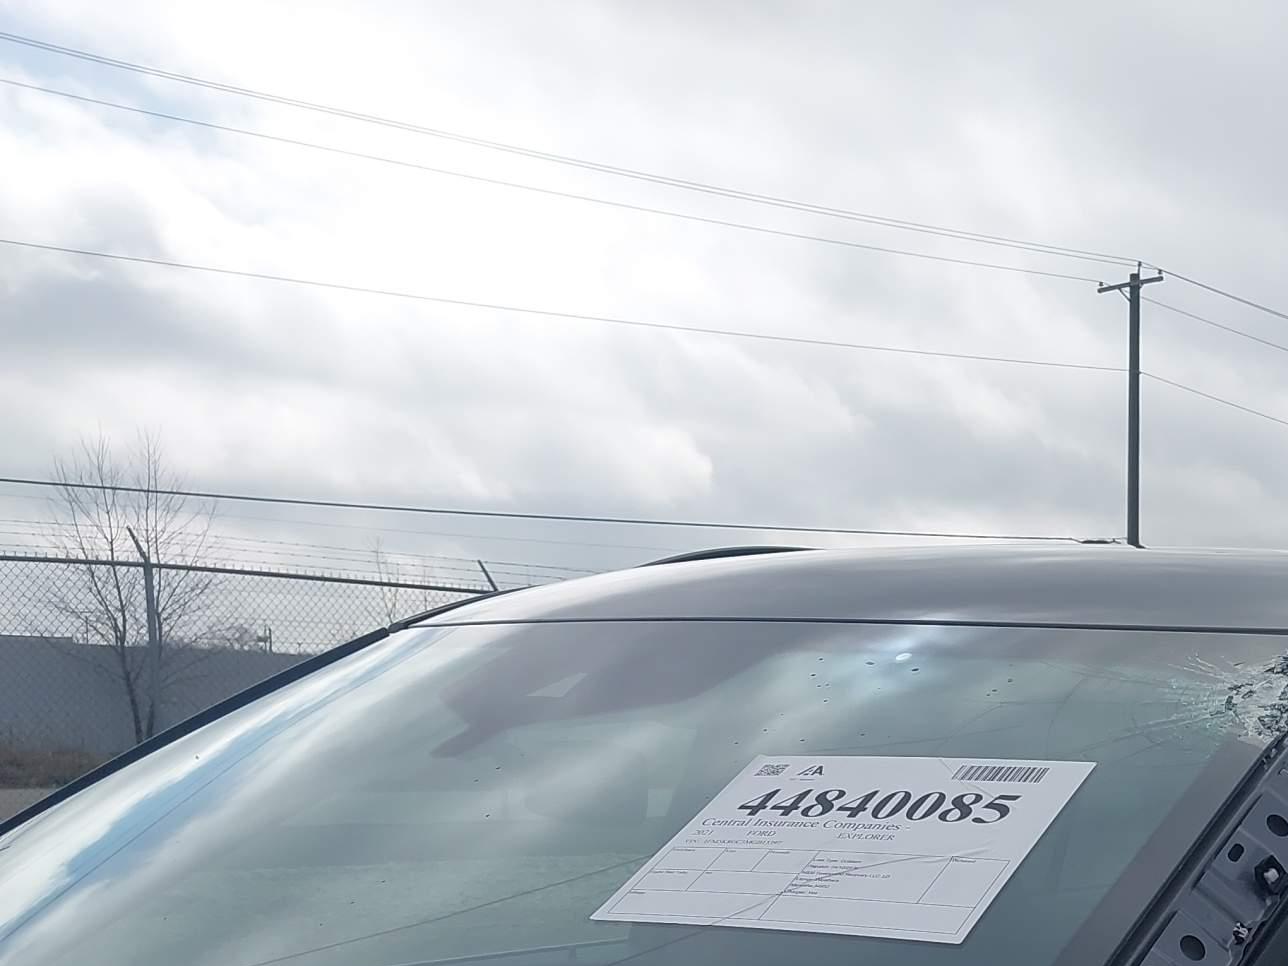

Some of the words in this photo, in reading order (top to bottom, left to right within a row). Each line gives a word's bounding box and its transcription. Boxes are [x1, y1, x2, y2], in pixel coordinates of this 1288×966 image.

[737, 788, 1023, 825] 44840085
[702, 818, 752, 828] Central
[753, 818, 820, 829] Insurance
[823, 819, 901, 832] Companies
[746, 830, 777, 838] FORD
[837, 832, 896, 842] EXPLORER
